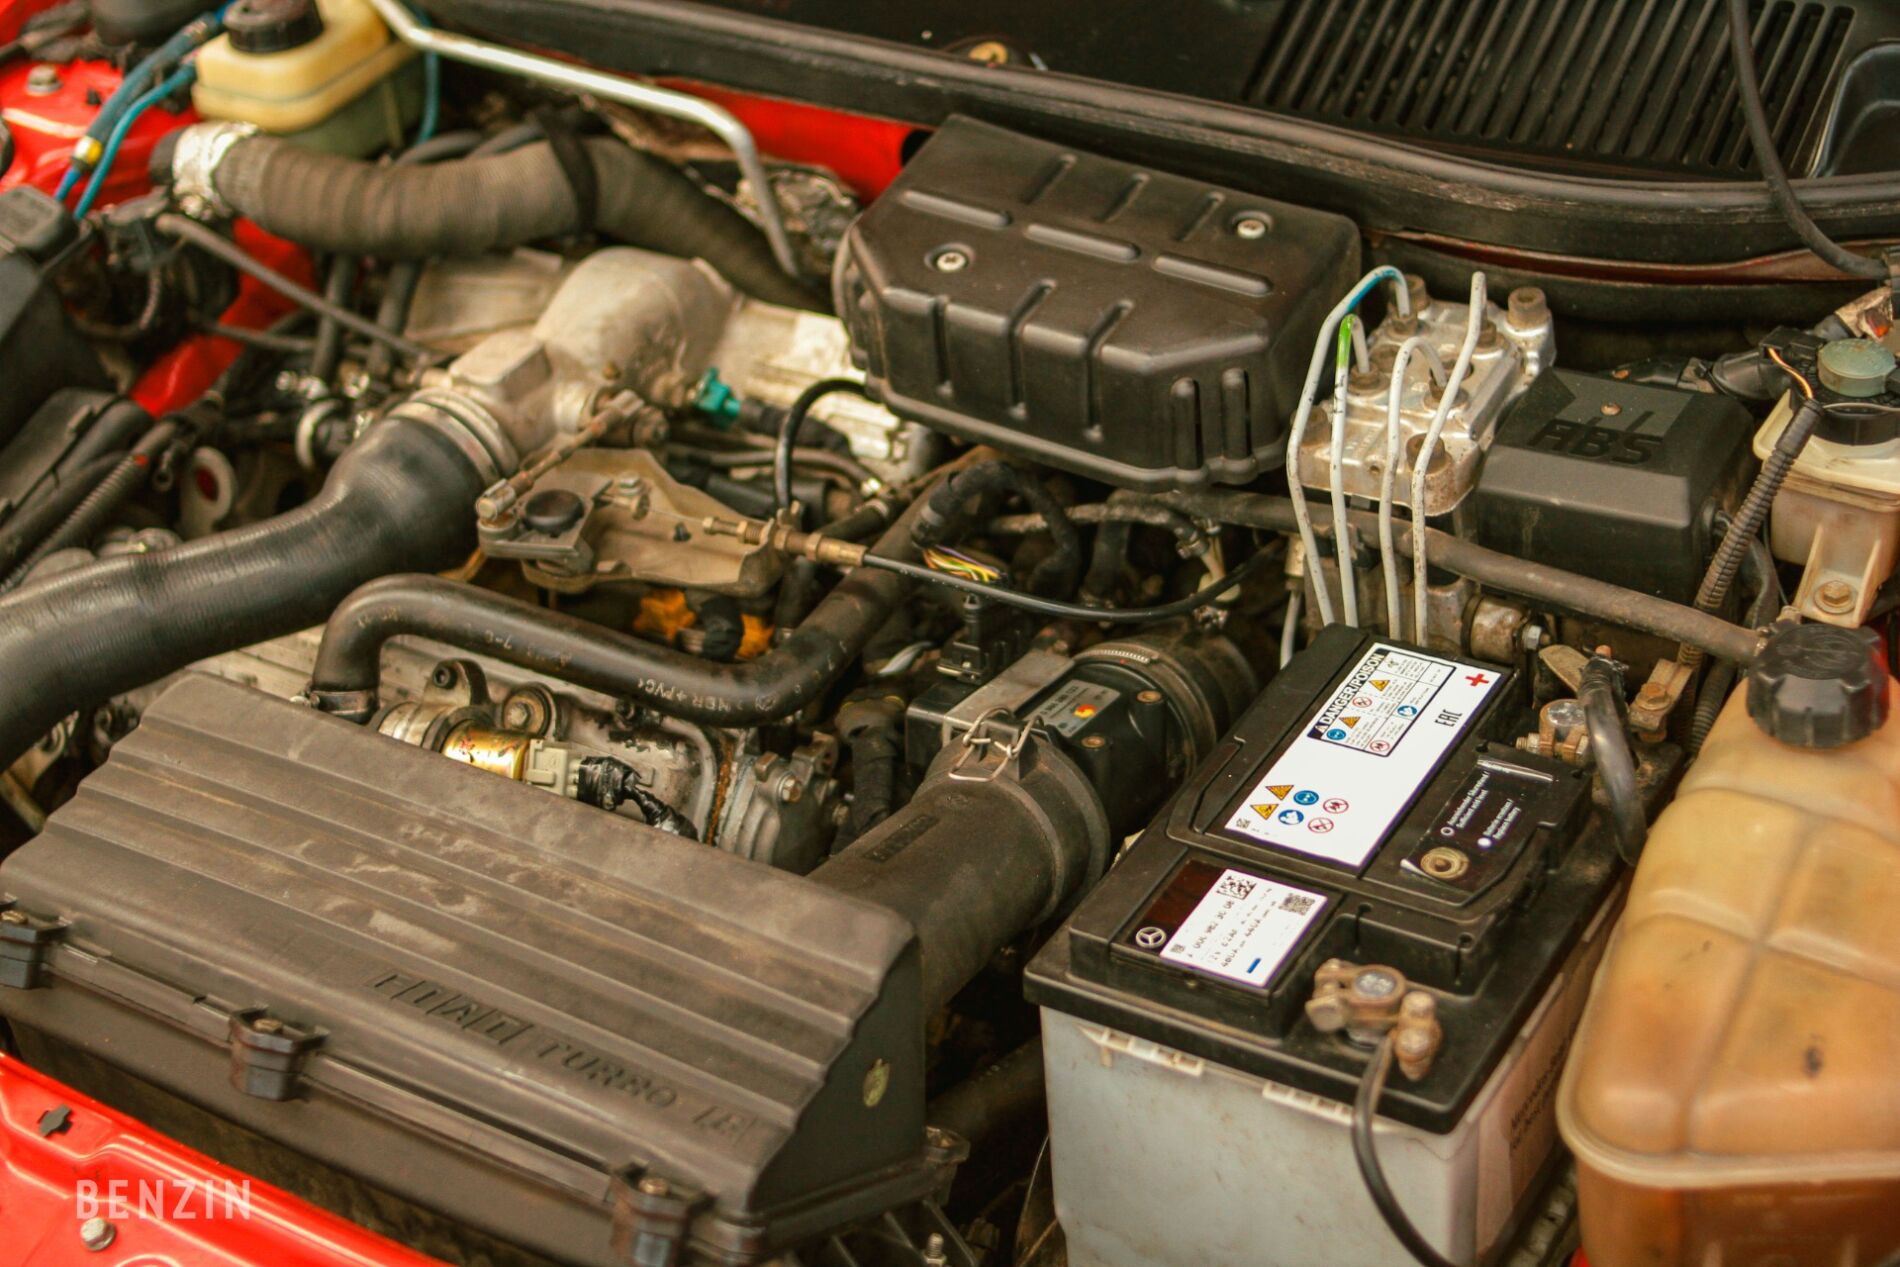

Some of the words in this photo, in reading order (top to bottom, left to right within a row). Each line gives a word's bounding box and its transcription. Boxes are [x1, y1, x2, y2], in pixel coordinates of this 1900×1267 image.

[1526, 418, 1664, 464] ABS
[1321, 653, 1385, 724] DANGER/POISON
[1434, 709, 1463, 727] EAC
[372, 971, 528, 1042] FIAT
[537, 1042, 677, 1108] TURBO
